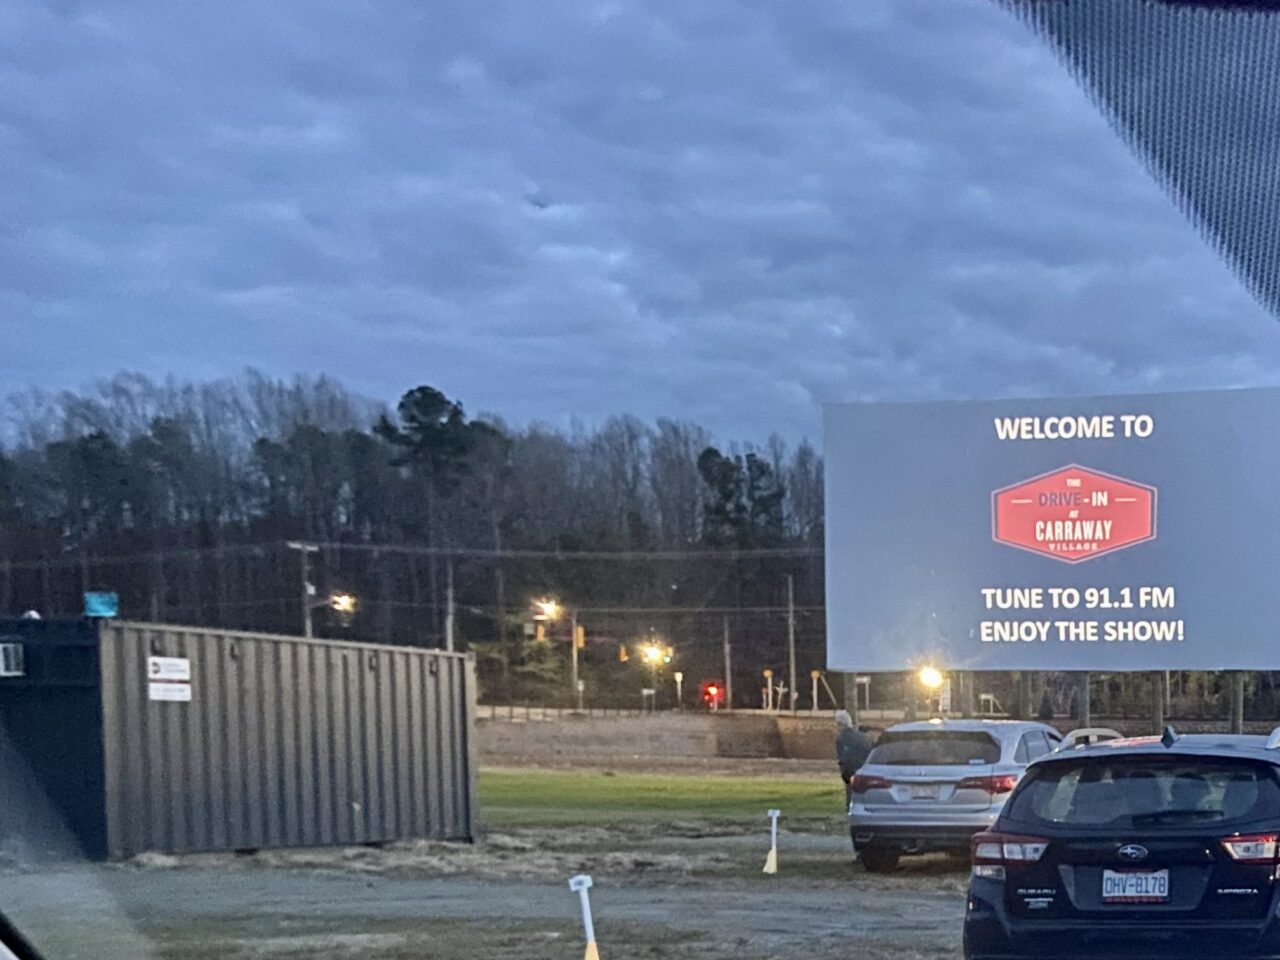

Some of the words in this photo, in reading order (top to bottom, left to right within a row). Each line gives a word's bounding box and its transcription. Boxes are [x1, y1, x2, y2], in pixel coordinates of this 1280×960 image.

[994, 415, 1114, 440] WELCOME
[1120, 414, 1154, 437] TO
[1066, 478, 1081, 487] THE
[1068, 510, 1079, 518] AT
[1035, 520, 1112, 541] CARRAWAY
[981, 587, 1043, 609] TUNE
[1048, 587, 1080, 608] TO
[1084, 587, 1134, 608] 91.1
[1139, 586, 1175, 608] FM
[980, 620, 1051, 642] ENJOY
[1055, 620, 1099, 641] THE
[1103, 619, 1184, 641] SHOW!
